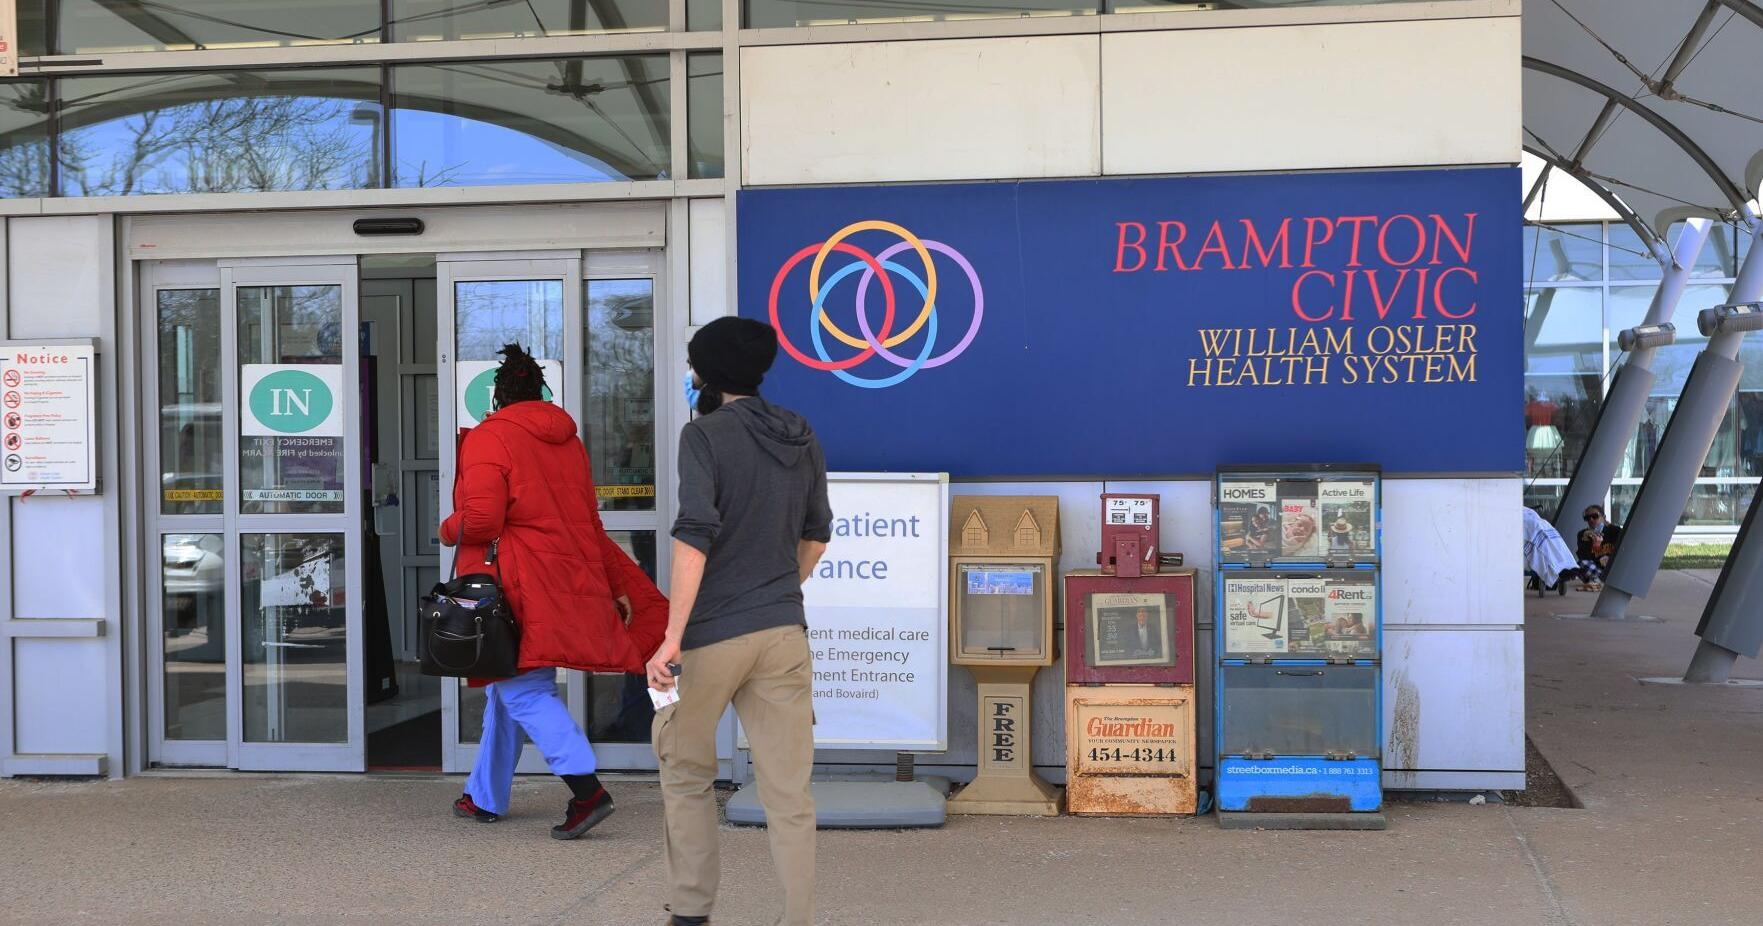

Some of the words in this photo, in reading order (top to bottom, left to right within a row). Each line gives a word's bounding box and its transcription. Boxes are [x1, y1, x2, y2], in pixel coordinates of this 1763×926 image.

[1112, 213, 1479, 273] BRAMPTON
[1291, 267, 1479, 322] CIVIC
[1198, 327, 1354, 357] WILLIAM
[1367, 324, 1478, 355] OSLER
[17, 353, 68, 364] Notice
[1187, 356, 1329, 387] HEALTH
[1342, 353, 1478, 384] SYSTEM
[269, 388, 312, 416] IN
[259, 491, 302, 499] AUTOMATIC
[305, 491, 328, 499] DOOR
[1223, 489, 1265, 499] HOMES
[1322, 488, 1348, 497] Active
[1349, 488, 1365, 497] Life
[830, 512, 920, 537] atient
[1266, 584, 1285, 592] News
[1230, 611, 1247, 621] safe
[838, 627, 895, 640] medical
[899, 630, 929, 641] care
[828, 647, 910, 664] Emergency
[812, 669, 847, 681] ment
[851, 668, 915, 682] Entrance
[812, 688, 833, 698] and
[836, 688, 879, 700] Bovaird)
[992, 702, 1015, 762] FREE
[1087, 716, 1175, 737] Guardian
[1087, 747, 1177, 762] 454-4344
[1227, 765, 1317, 774] streetboxmedia.ca
